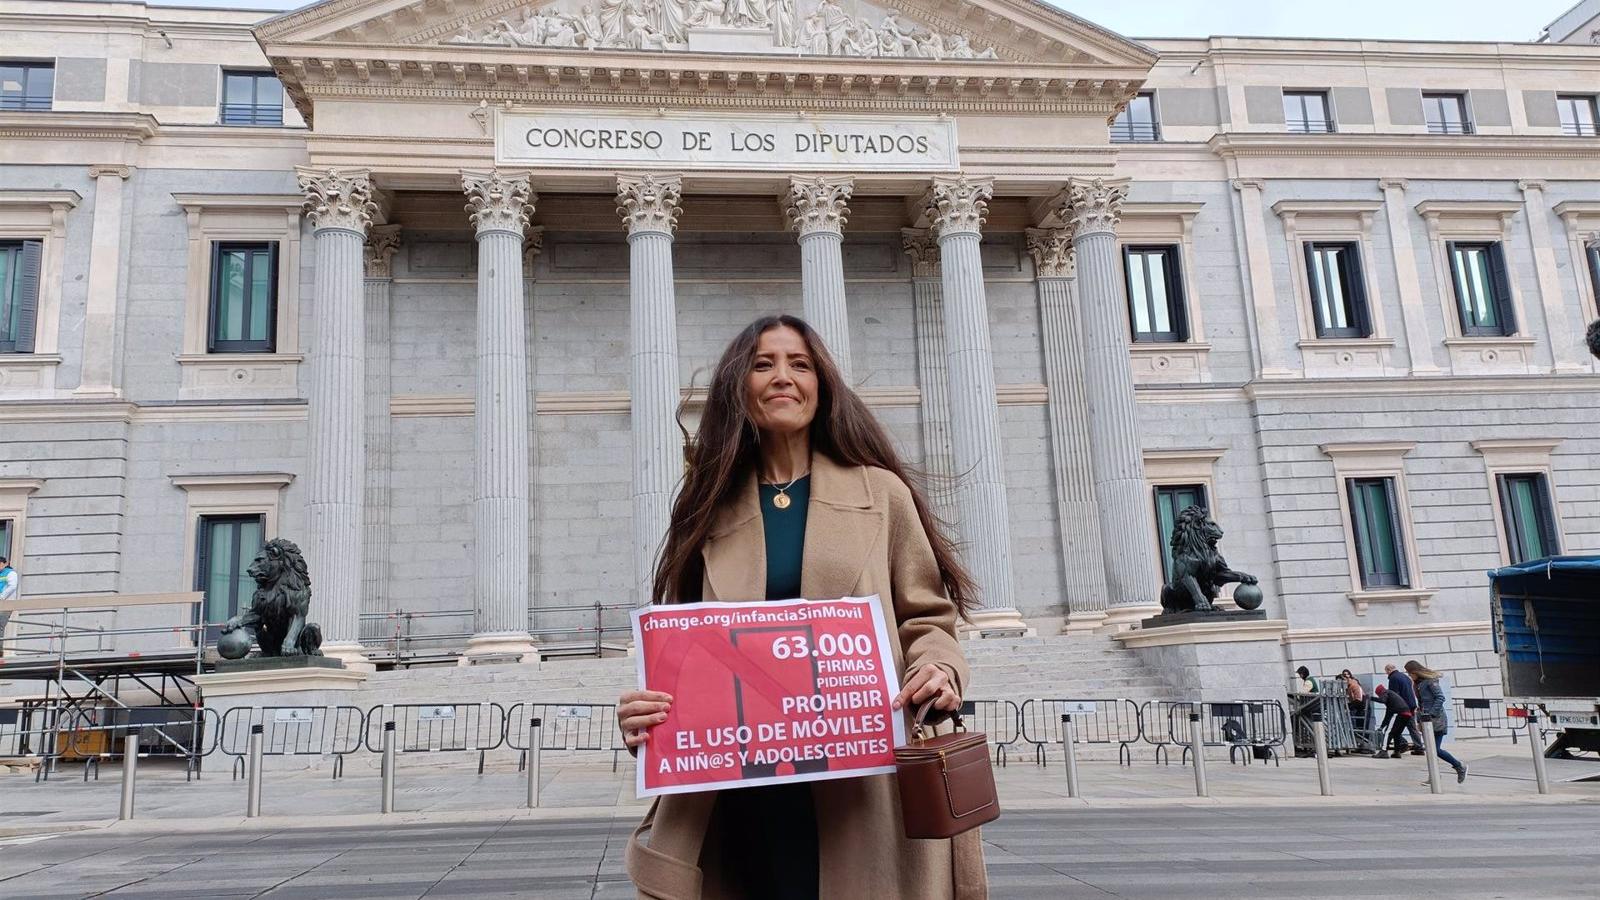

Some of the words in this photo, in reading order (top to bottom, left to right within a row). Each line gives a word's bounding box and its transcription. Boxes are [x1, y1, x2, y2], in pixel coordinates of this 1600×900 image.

[526, 128, 663, 151] CONGRESO
[682, 132, 712, 151] DE
[731, 133, 775, 152] LOS
[795, 133, 929, 154] DIPUTADOS
[644, 606, 862, 631] change.org/infanciaSinMovil
[772, 633, 872, 659] 63.000
[817, 659, 875, 673] FIRMAS
[816, 674, 878, 689] PIDIENDO
[782, 690, 883, 715] PROHIBIR
[676, 732, 701, 750] EL
[706, 725, 752, 746] USO
[758, 723, 786, 742] DE
[792, 714, 886, 738] MÓVILES
[659, 758, 672, 774] A
[676, 753, 735, 773] NIÑ@S
[739, 751, 750, 767] Y
[754, 738, 888, 765] ADOLESCENTES
